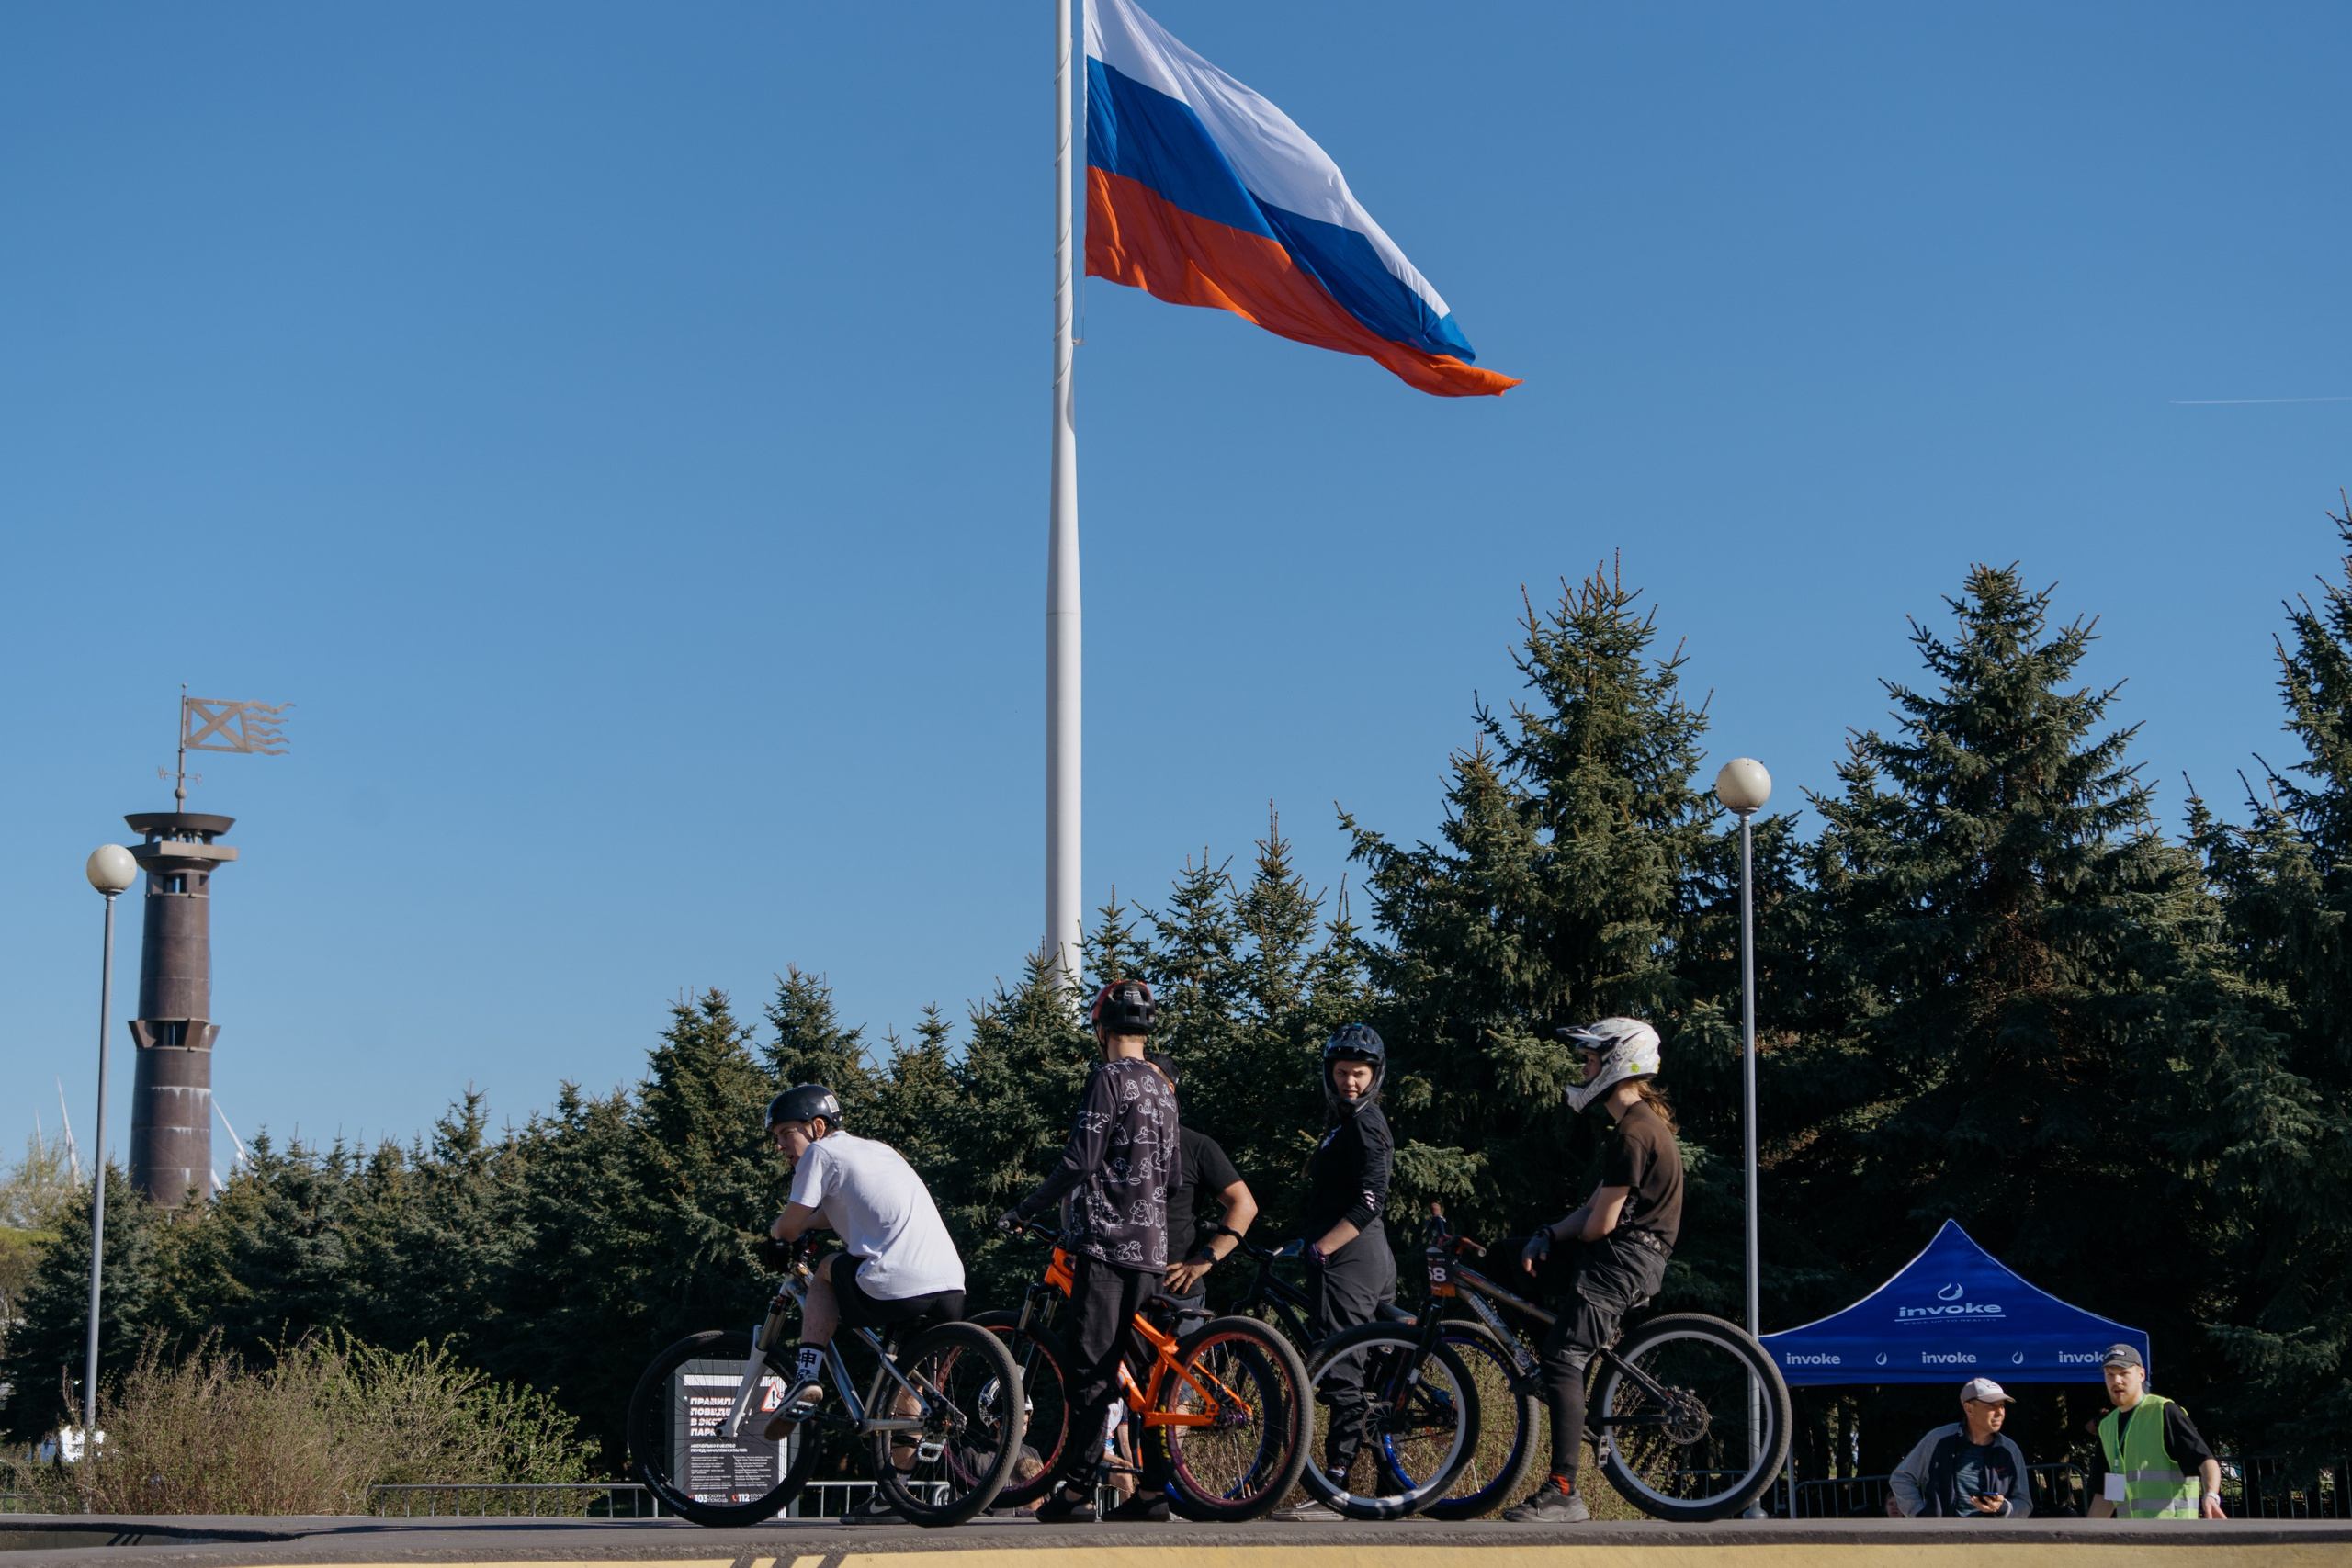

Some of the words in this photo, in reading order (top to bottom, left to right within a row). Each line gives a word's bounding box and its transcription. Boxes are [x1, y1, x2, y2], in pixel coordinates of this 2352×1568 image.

[1079, 1117, 1102, 1134] Cat
[1899, 1303, 2002, 1317] invoke
[1786, 1352, 1841, 1365] invoke
[1921, 1351, 1977, 1364] invoke
[2058, 1350, 2105, 1363] invok
[690, 1417, 698, 1427] В
[1159, 1404, 1171, 1459] MAXS
[644, 1464, 688, 1511] CONTINENTAL
[695, 1494, 708, 1503] 103
[738, 1493, 751, 1503] 112
